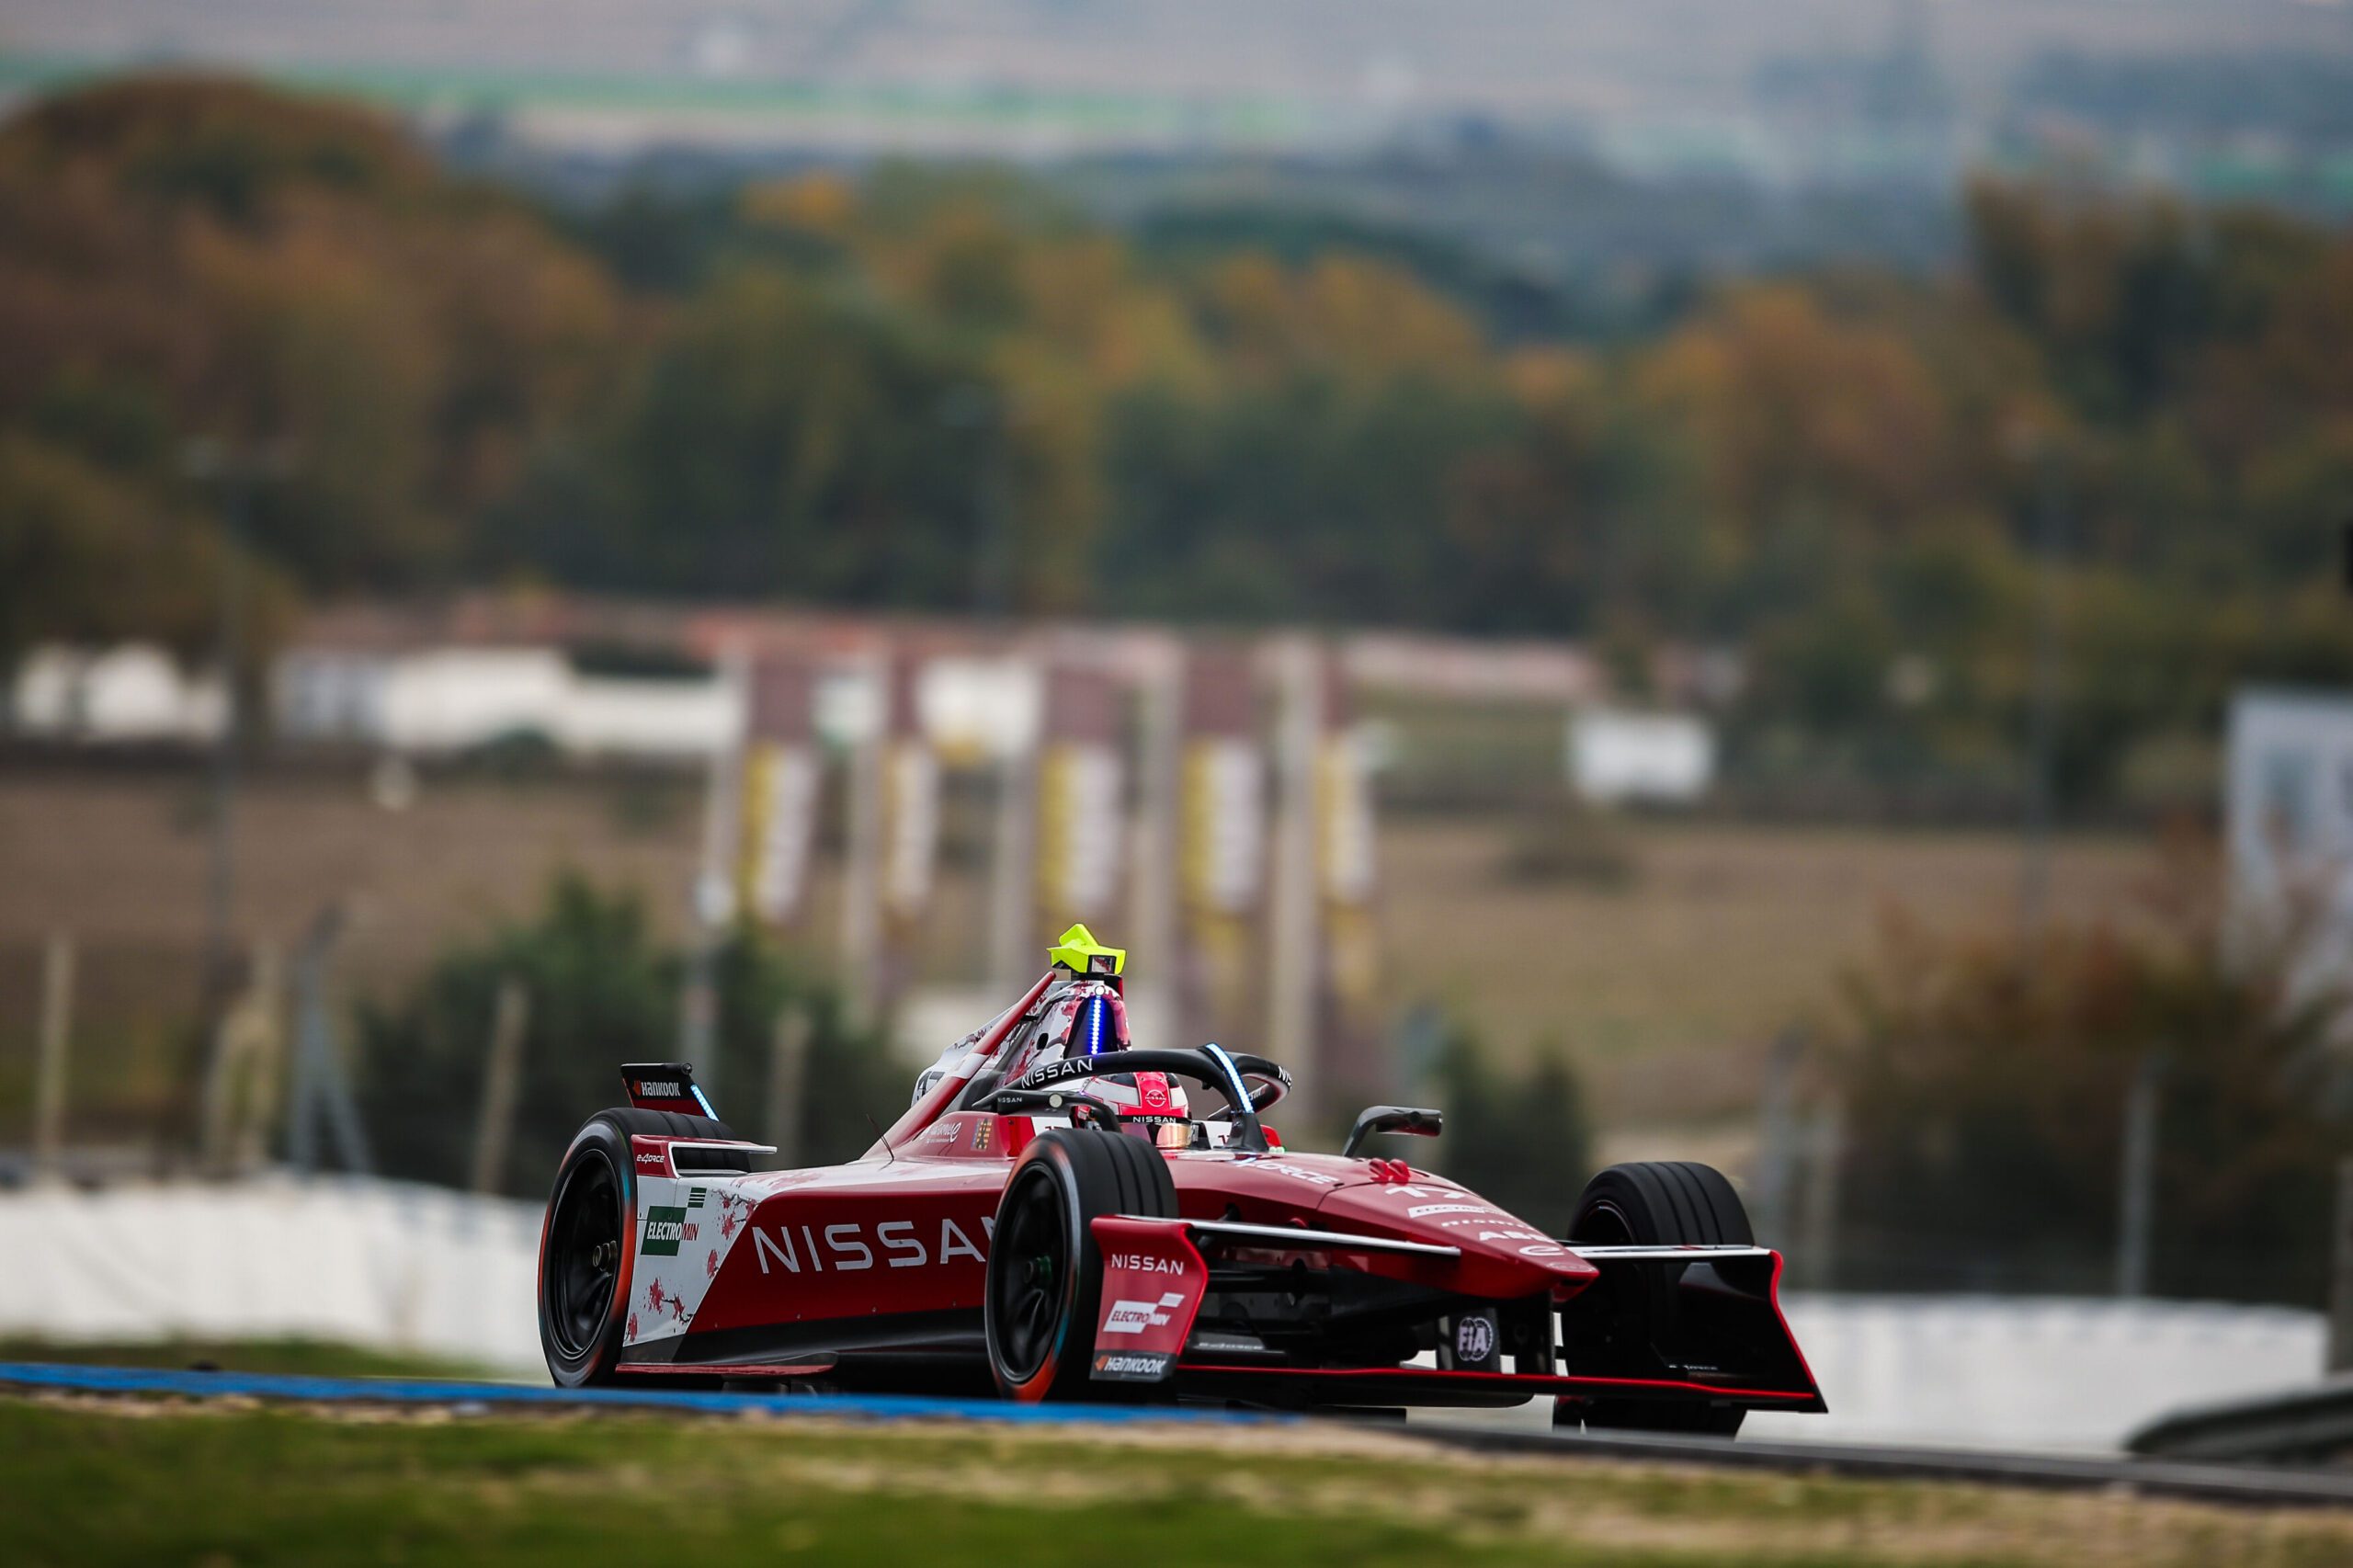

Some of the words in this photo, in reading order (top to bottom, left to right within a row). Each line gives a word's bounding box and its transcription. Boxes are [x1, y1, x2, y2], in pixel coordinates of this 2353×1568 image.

[1021, 1058, 1093, 1088] NISSAN
[646, 1221, 699, 1242] ELECTROMIN
[752, 1216, 996, 1274] NISSA
[1111, 1253, 1184, 1276] NISSAN
[1111, 1310, 1171, 1326] ELECTROMIN
[1458, 1326, 1489, 1352] FIA
